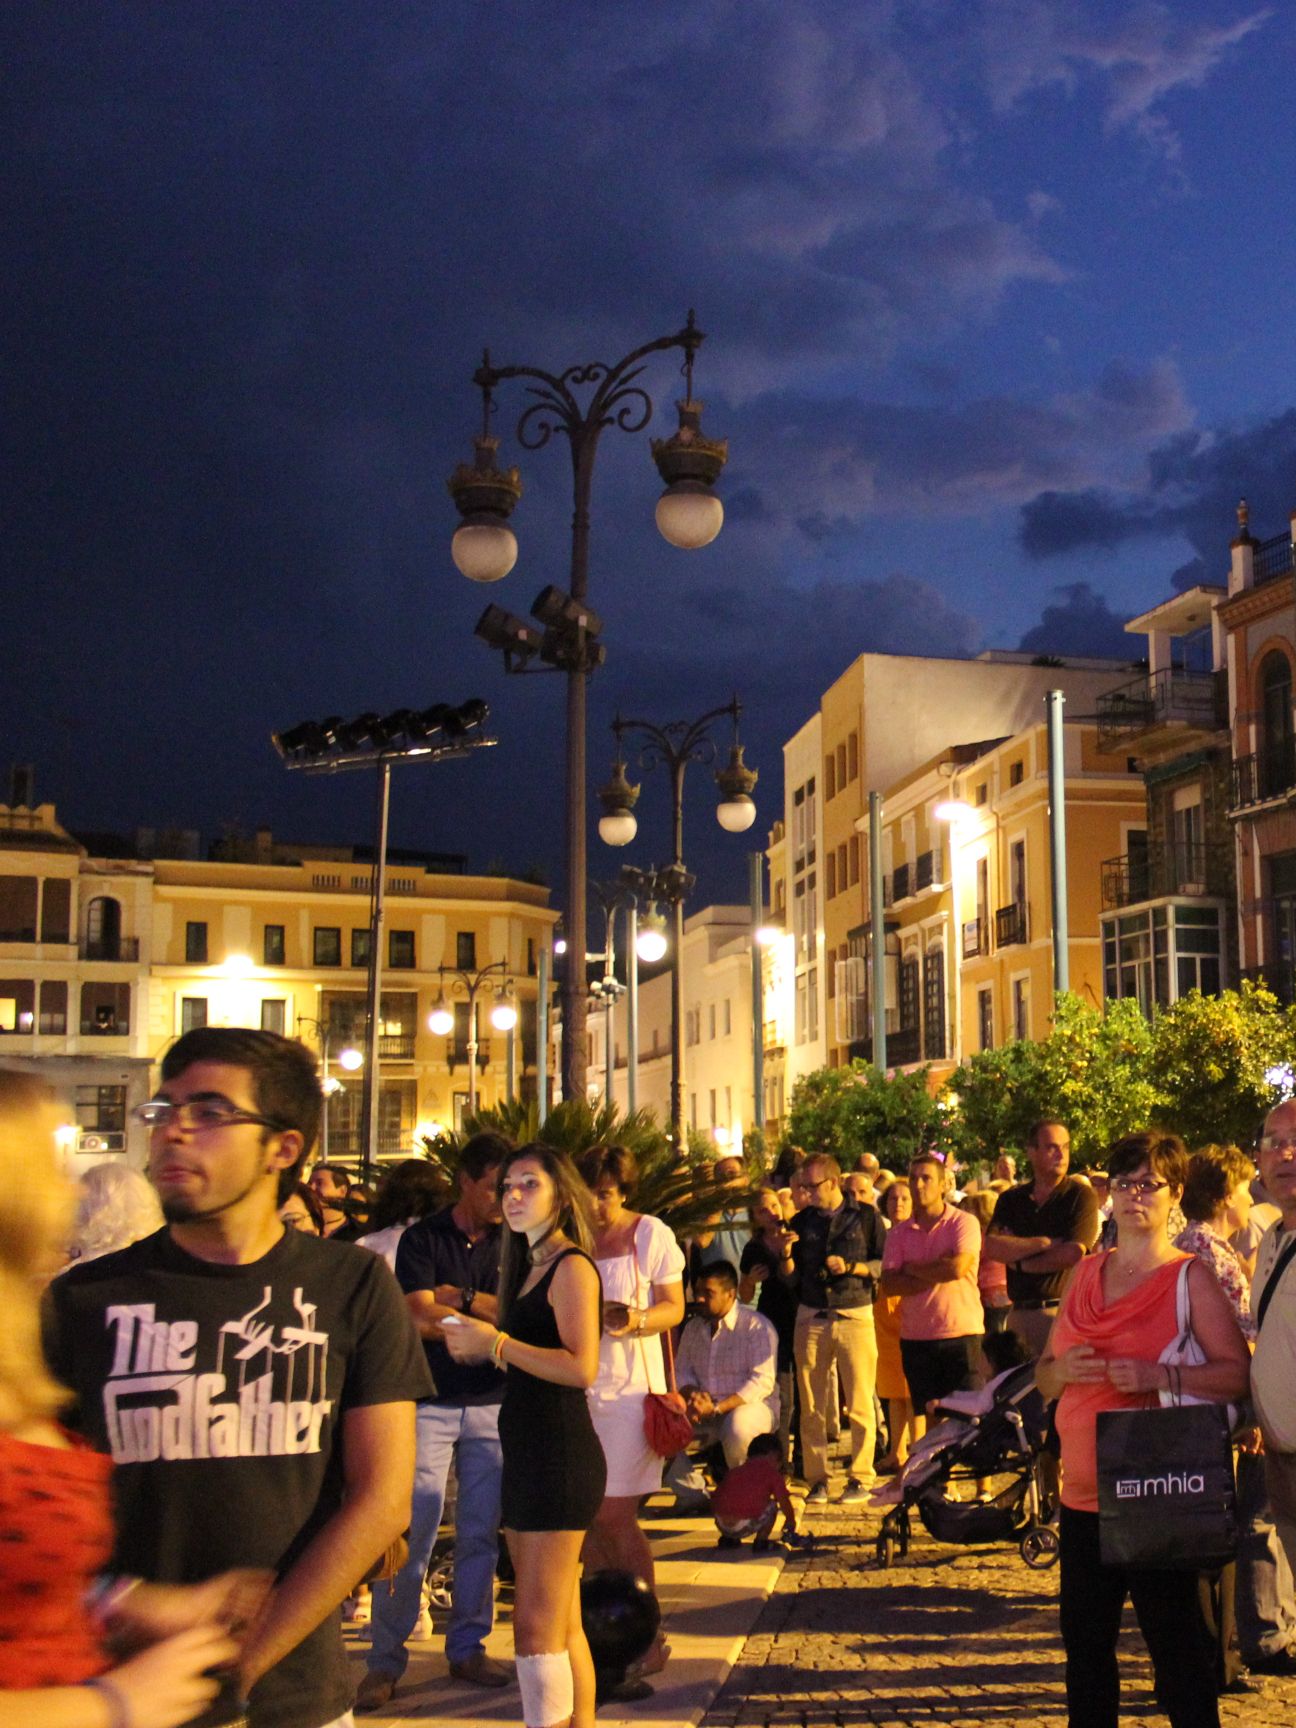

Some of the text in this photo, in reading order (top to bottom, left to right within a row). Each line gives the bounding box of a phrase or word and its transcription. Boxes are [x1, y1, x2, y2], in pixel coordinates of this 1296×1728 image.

[106, 1303, 198, 1377] The
[103, 1372, 333, 1464] Godfather
[1143, 1471, 1204, 1496] mhia
